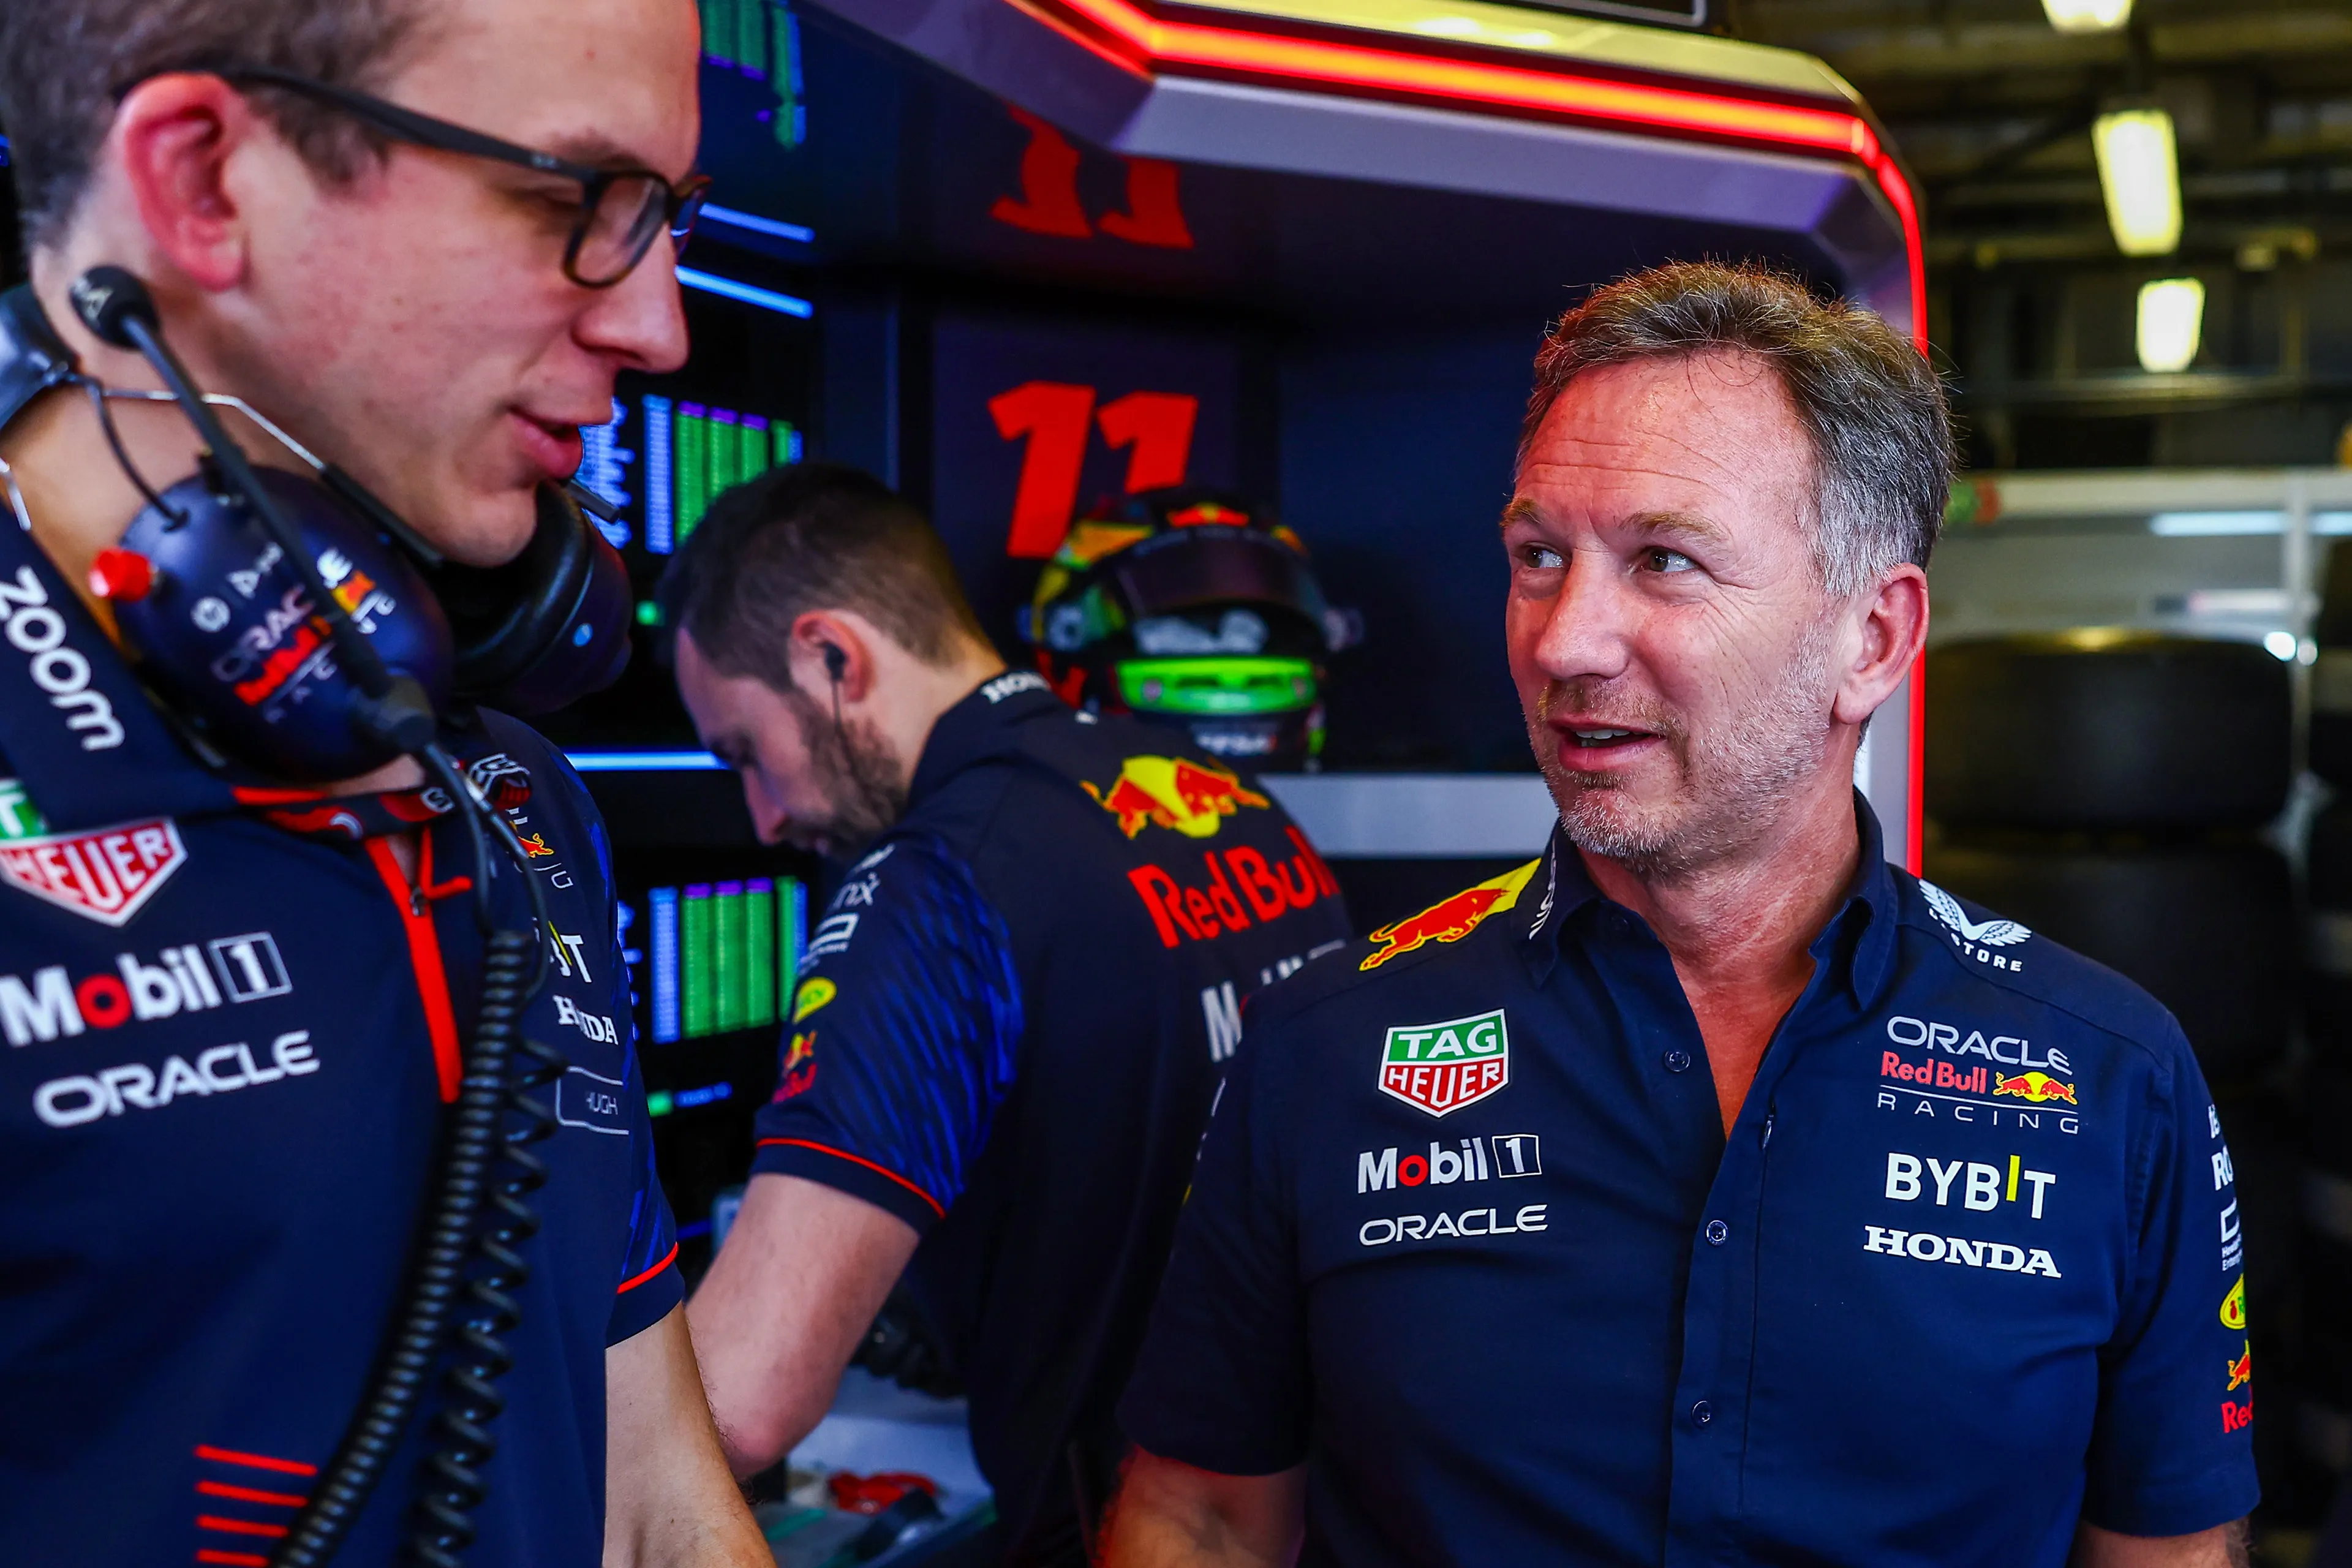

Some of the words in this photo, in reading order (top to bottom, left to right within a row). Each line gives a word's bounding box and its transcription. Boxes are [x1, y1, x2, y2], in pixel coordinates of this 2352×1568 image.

[987, 380, 1199, 560] 11
[0, 565, 125, 751] zoom
[2, 827, 169, 908] HEUER
[1126, 850, 1252, 949] Red
[0, 943, 222, 1047] Mobil
[1398, 1022, 1497, 1059] TAG
[1887, 1016, 2073, 1076] ORACLE
[32, 1029, 321, 1128] ORACLE
[1387, 1061, 1500, 1109] HEUER
[1881, 1050, 1935, 1085] Red
[1935, 1061, 1988, 1095] Bull
[1877, 1091, 2079, 1135] RACING
[1357, 1137, 1488, 1194] Mobil
[1885, 1152, 2057, 1219] BYBIT
[1359, 1204, 1548, 1246] ORACLE
[1863, 1225, 2062, 1279] HONDA
